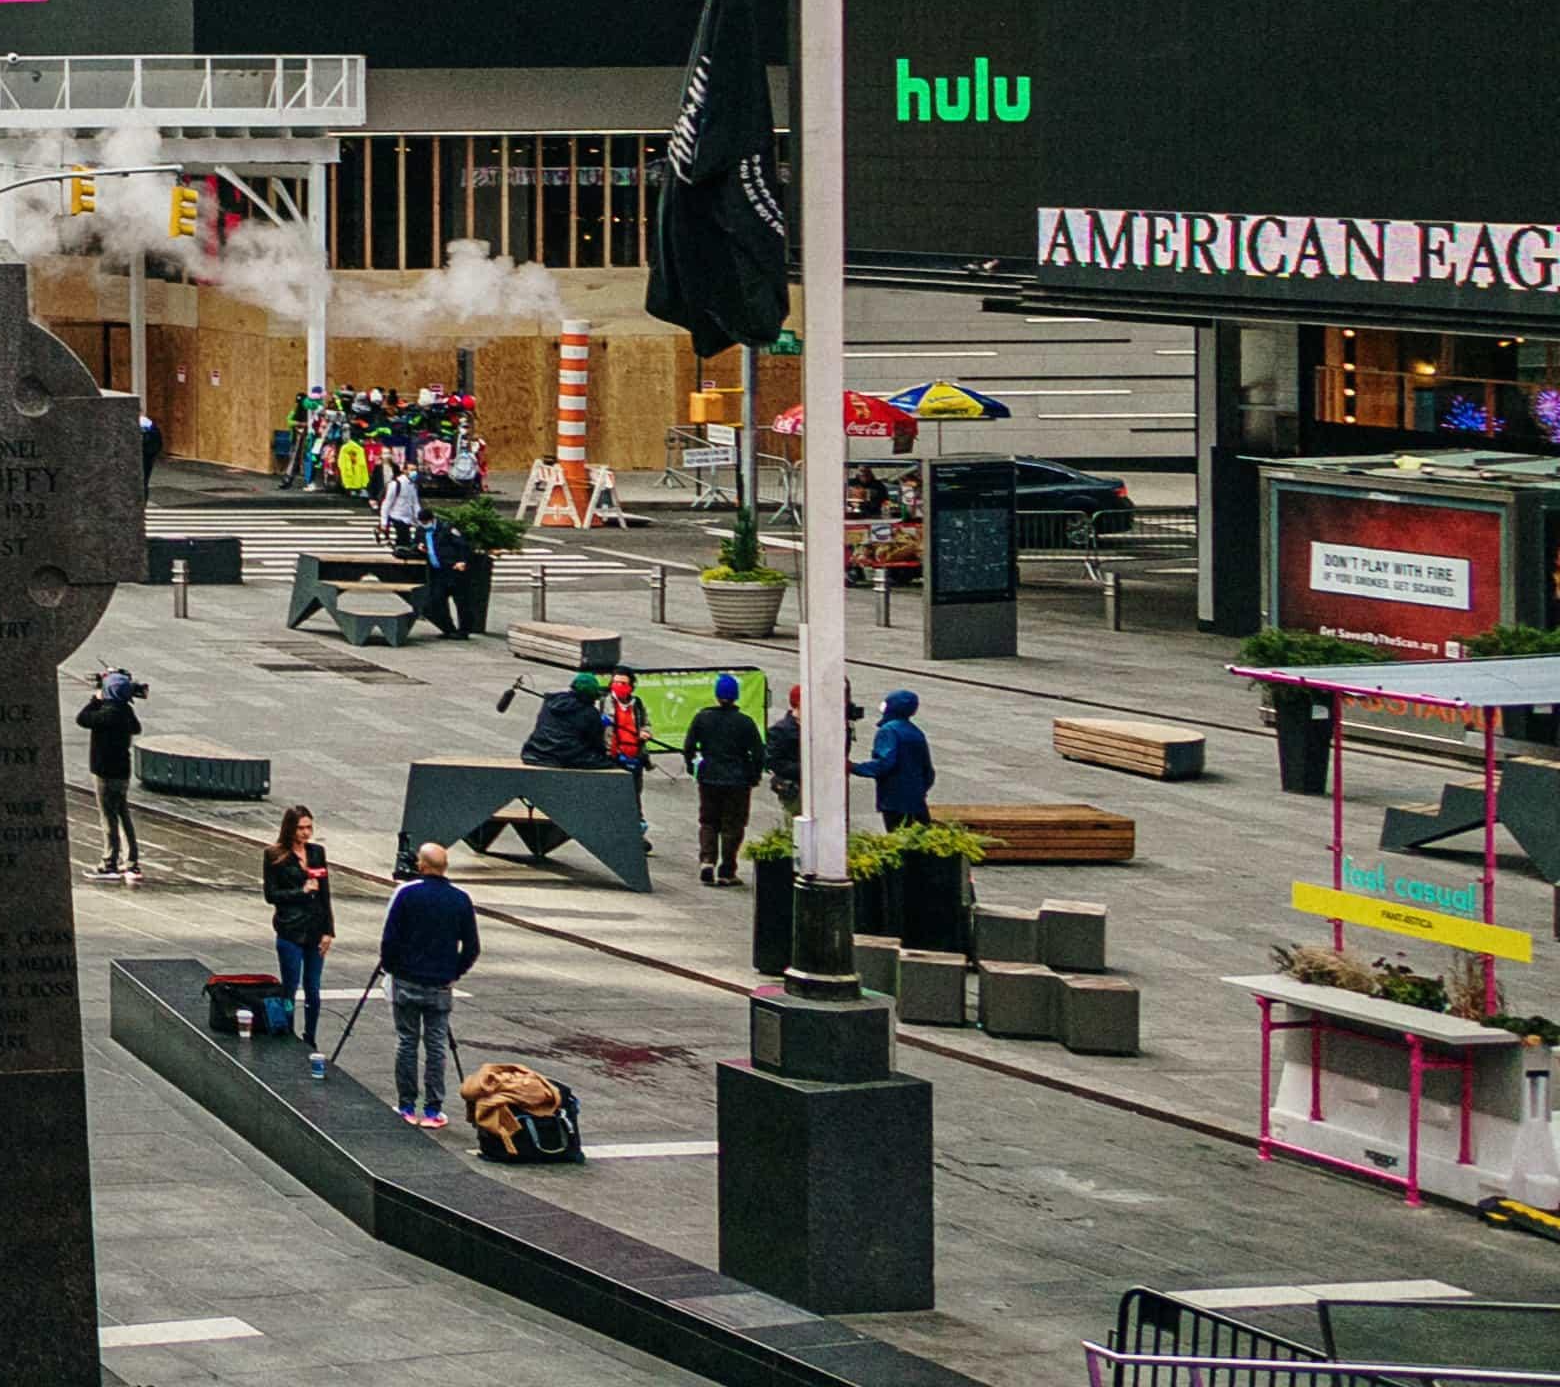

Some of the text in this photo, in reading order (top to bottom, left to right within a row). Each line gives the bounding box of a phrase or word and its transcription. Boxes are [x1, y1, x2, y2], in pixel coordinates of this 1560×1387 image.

[896, 57, 1031, 122] hulu
[1040, 209, 1392, 281] AMERICAN
[1323, 553, 1422, 578] DON'T PLAY WITH
[1342, 857, 1476, 913] fast casual
